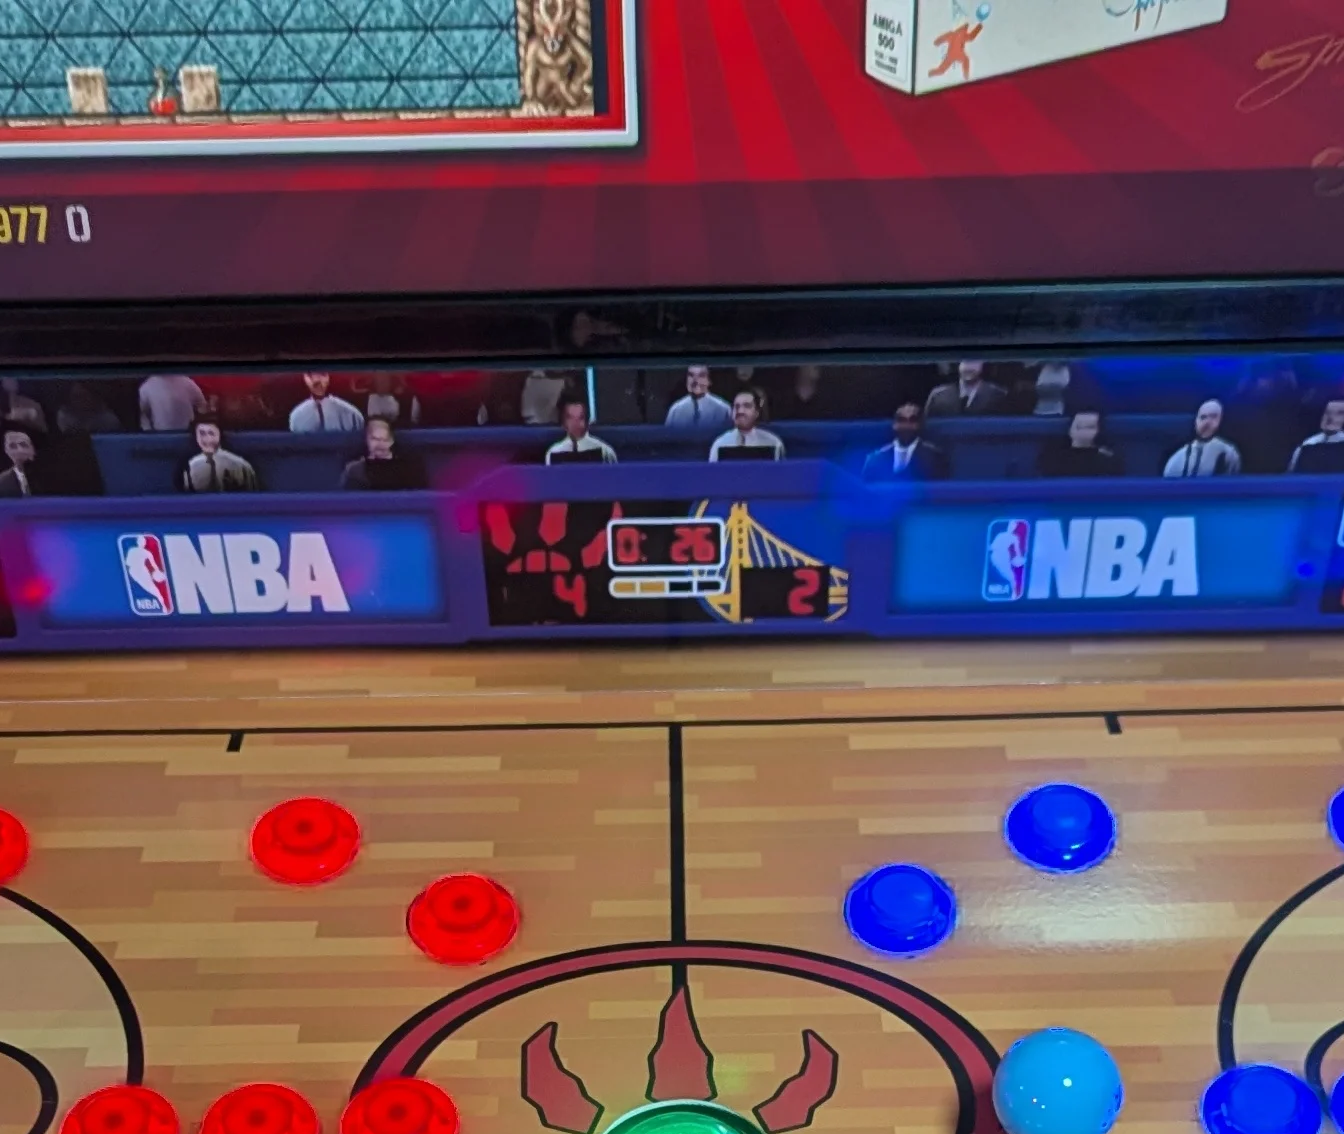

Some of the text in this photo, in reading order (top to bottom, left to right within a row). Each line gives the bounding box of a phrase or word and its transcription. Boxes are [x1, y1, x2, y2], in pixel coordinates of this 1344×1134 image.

[872, 12, 903, 37] AMIGA
[670, 526, 716, 562] 26
[1027, 516, 1199, 600] NBA
[163, 532, 351, 614] NBA
[136, 598, 161, 611] NBA
[553, 573, 587, 618] 4
